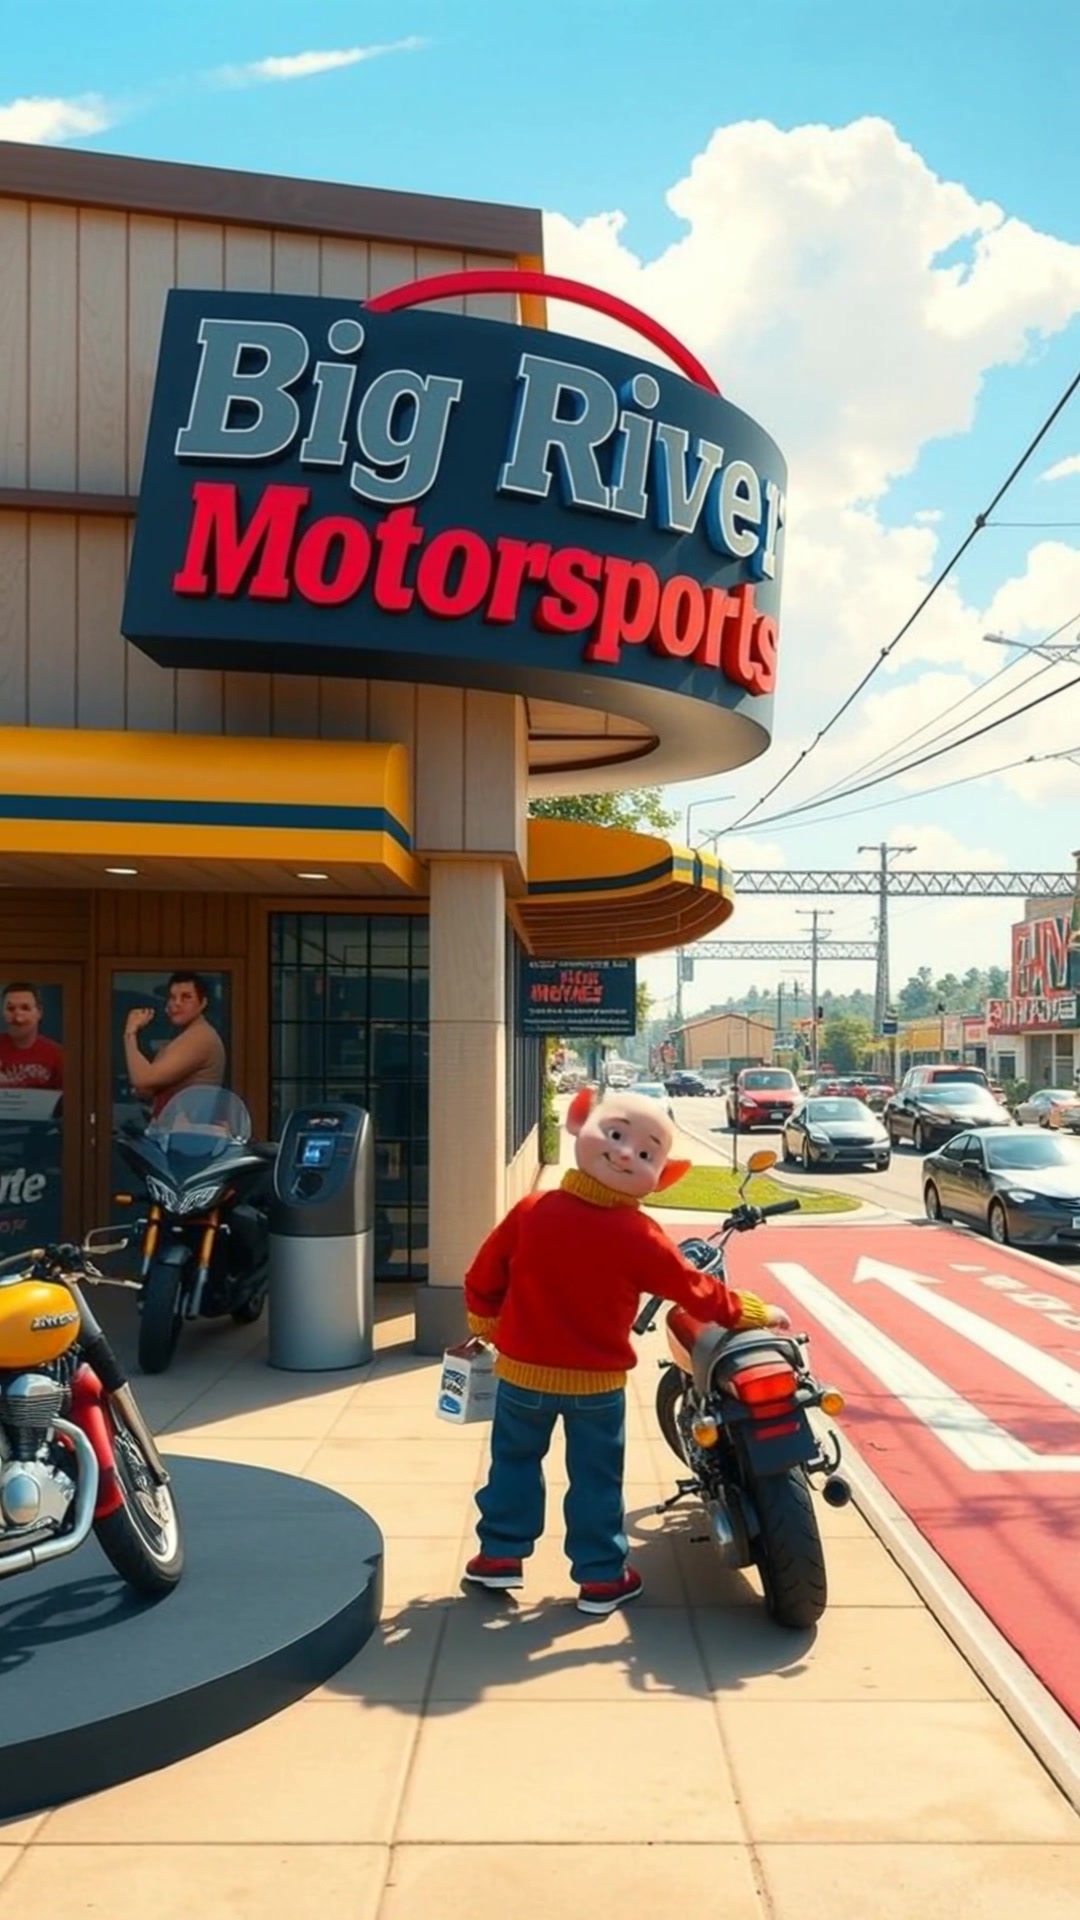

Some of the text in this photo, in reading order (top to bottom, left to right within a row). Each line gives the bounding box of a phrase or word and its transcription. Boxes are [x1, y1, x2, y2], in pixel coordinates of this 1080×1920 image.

[174, 318, 785, 580] Big River
[172, 482, 778, 696] Motorsports
